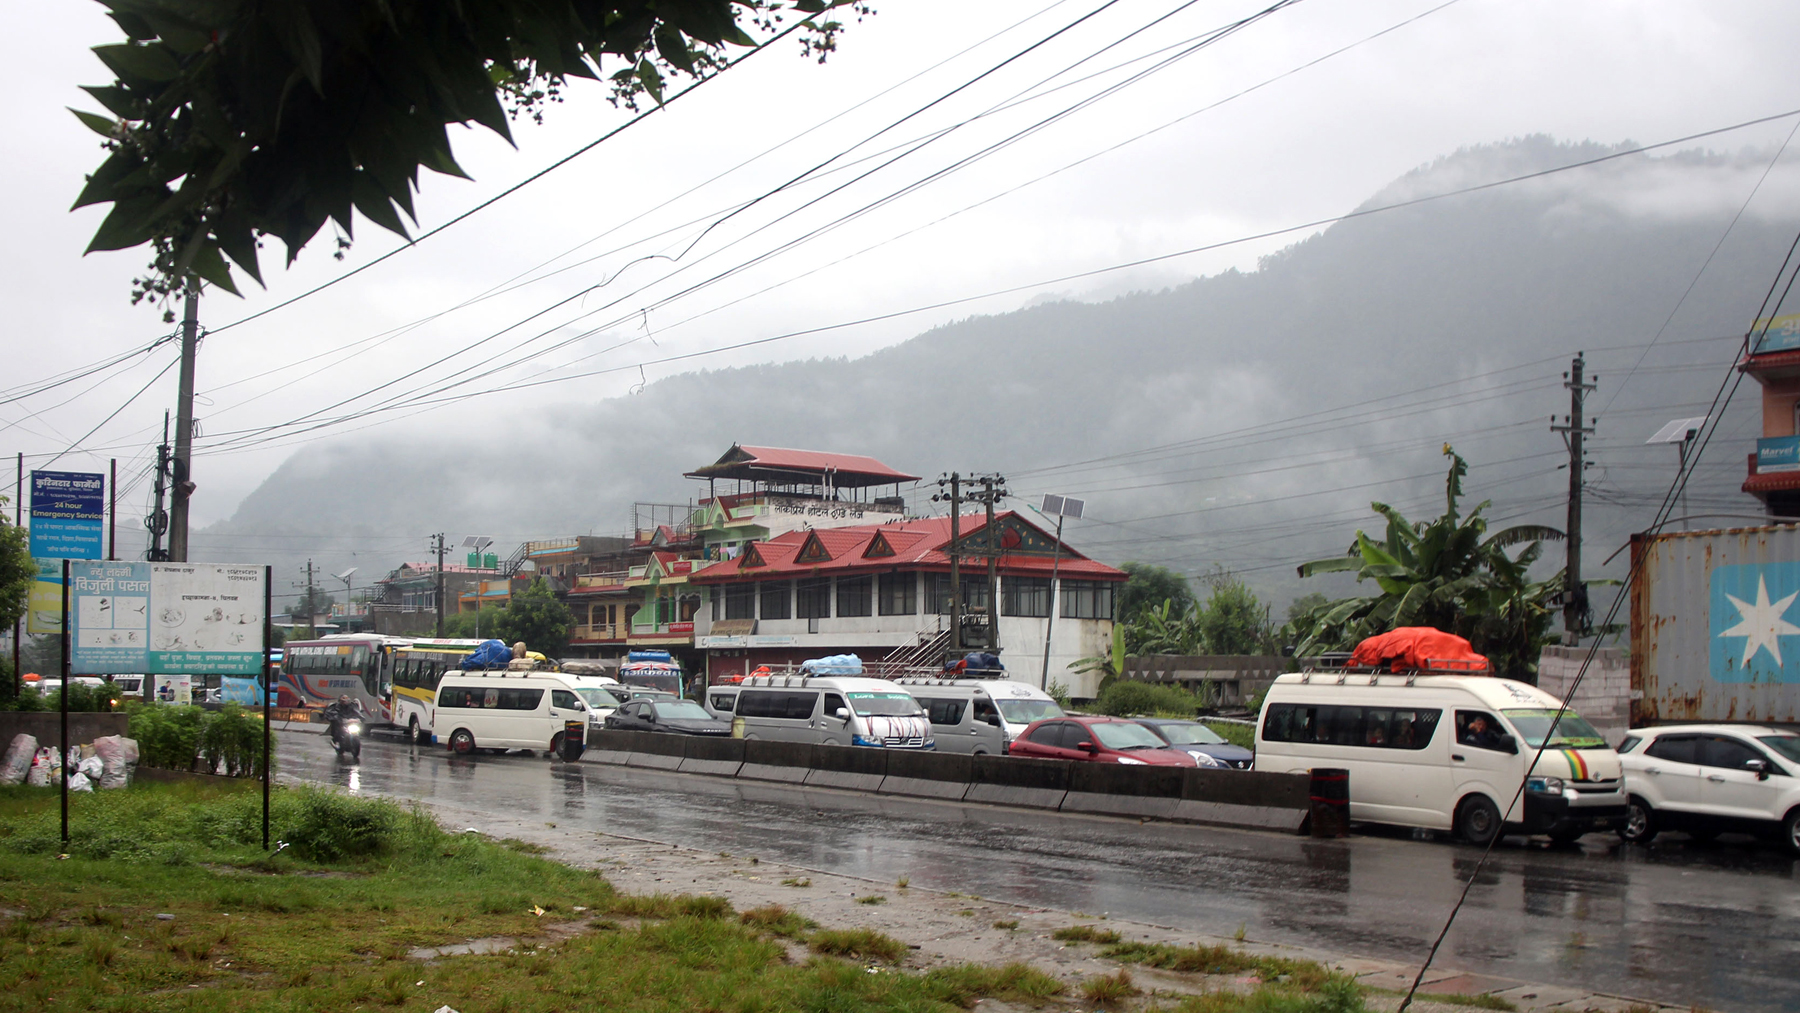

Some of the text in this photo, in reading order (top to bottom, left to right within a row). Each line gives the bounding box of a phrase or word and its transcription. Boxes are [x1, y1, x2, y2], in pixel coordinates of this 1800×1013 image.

[1760, 446, 1794, 456] Marvel
[33, 510, 75, 519] Emergency
[90, 568, 105, 579] न्यू
[118, 580, 150, 592] पसल
